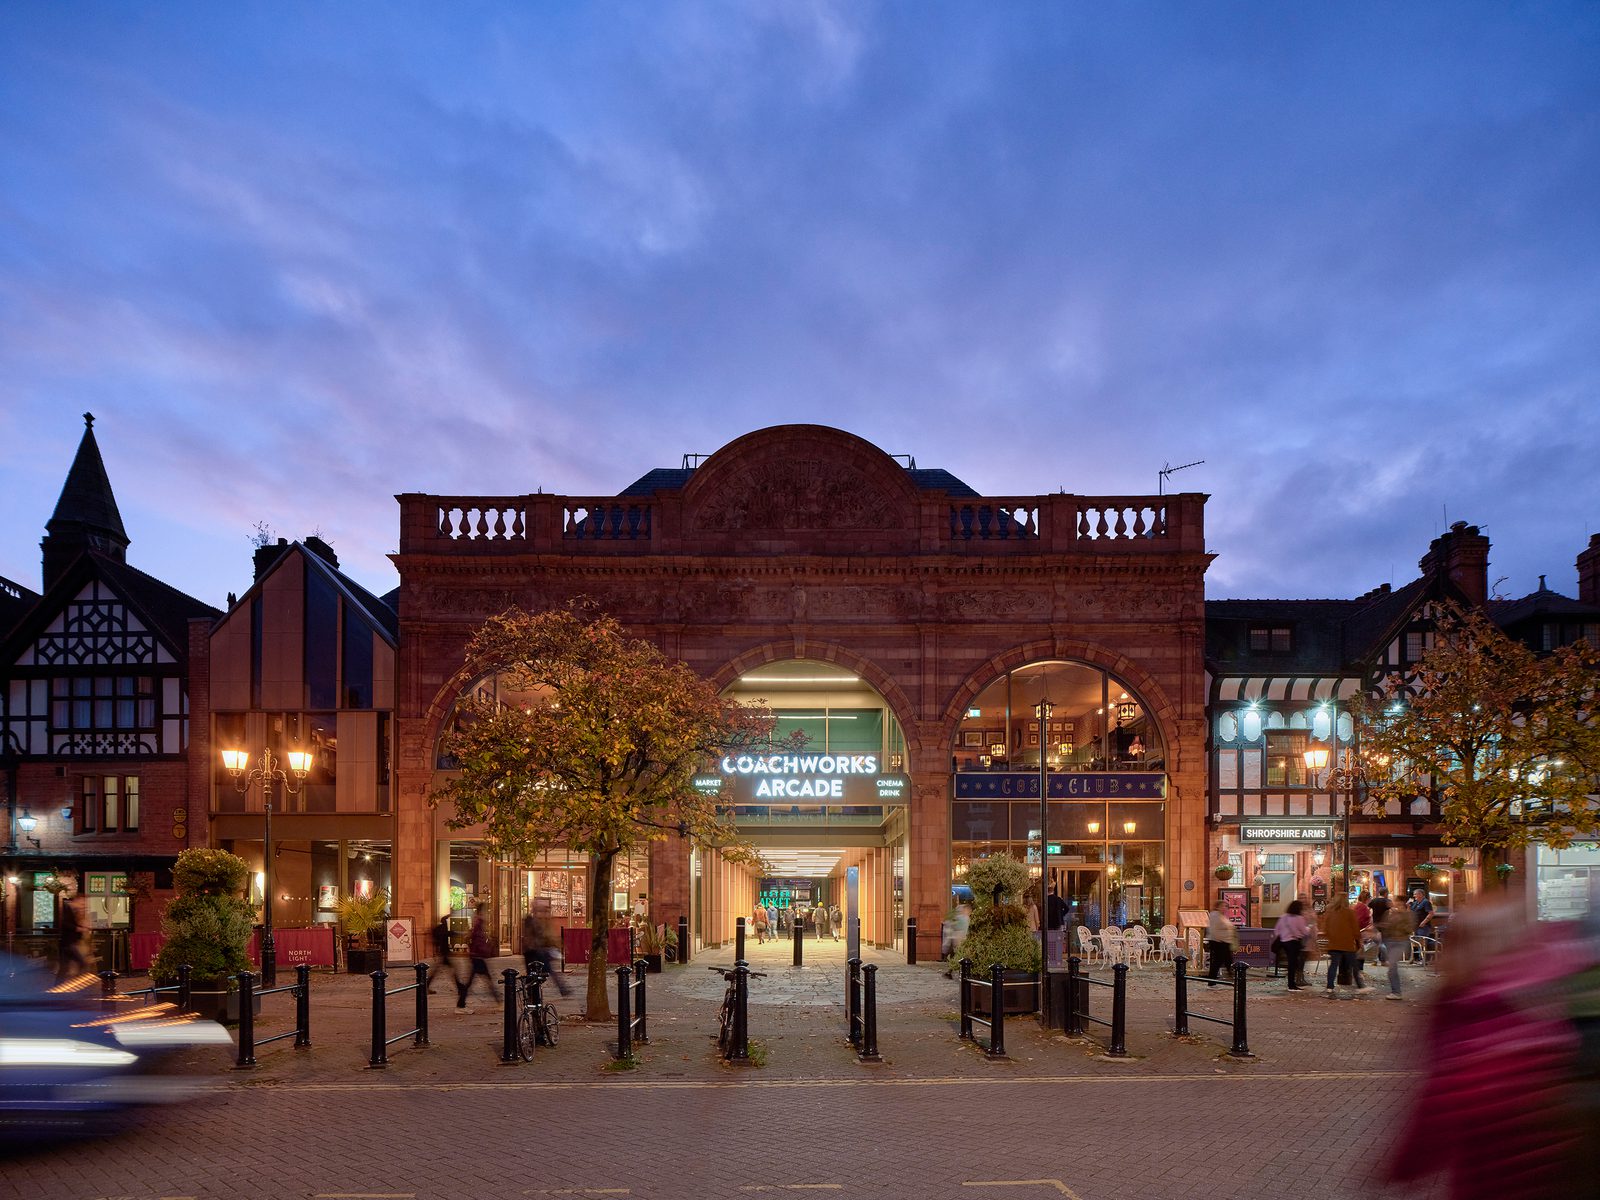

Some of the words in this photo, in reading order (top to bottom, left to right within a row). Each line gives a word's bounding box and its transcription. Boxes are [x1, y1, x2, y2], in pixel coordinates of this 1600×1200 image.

[722, 756, 877, 774] COACHWORKS
[695, 779, 722, 787] MARKET
[876, 779, 904, 787] CINEMA
[1069, 778, 1120, 794] CLUB
[756, 779, 843, 797] ARCADE
[879, 789, 900, 797] DRINK
[1246, 829, 1300, 838] SHROPSHIRE
[1301, 829, 1327, 838] ARMS
